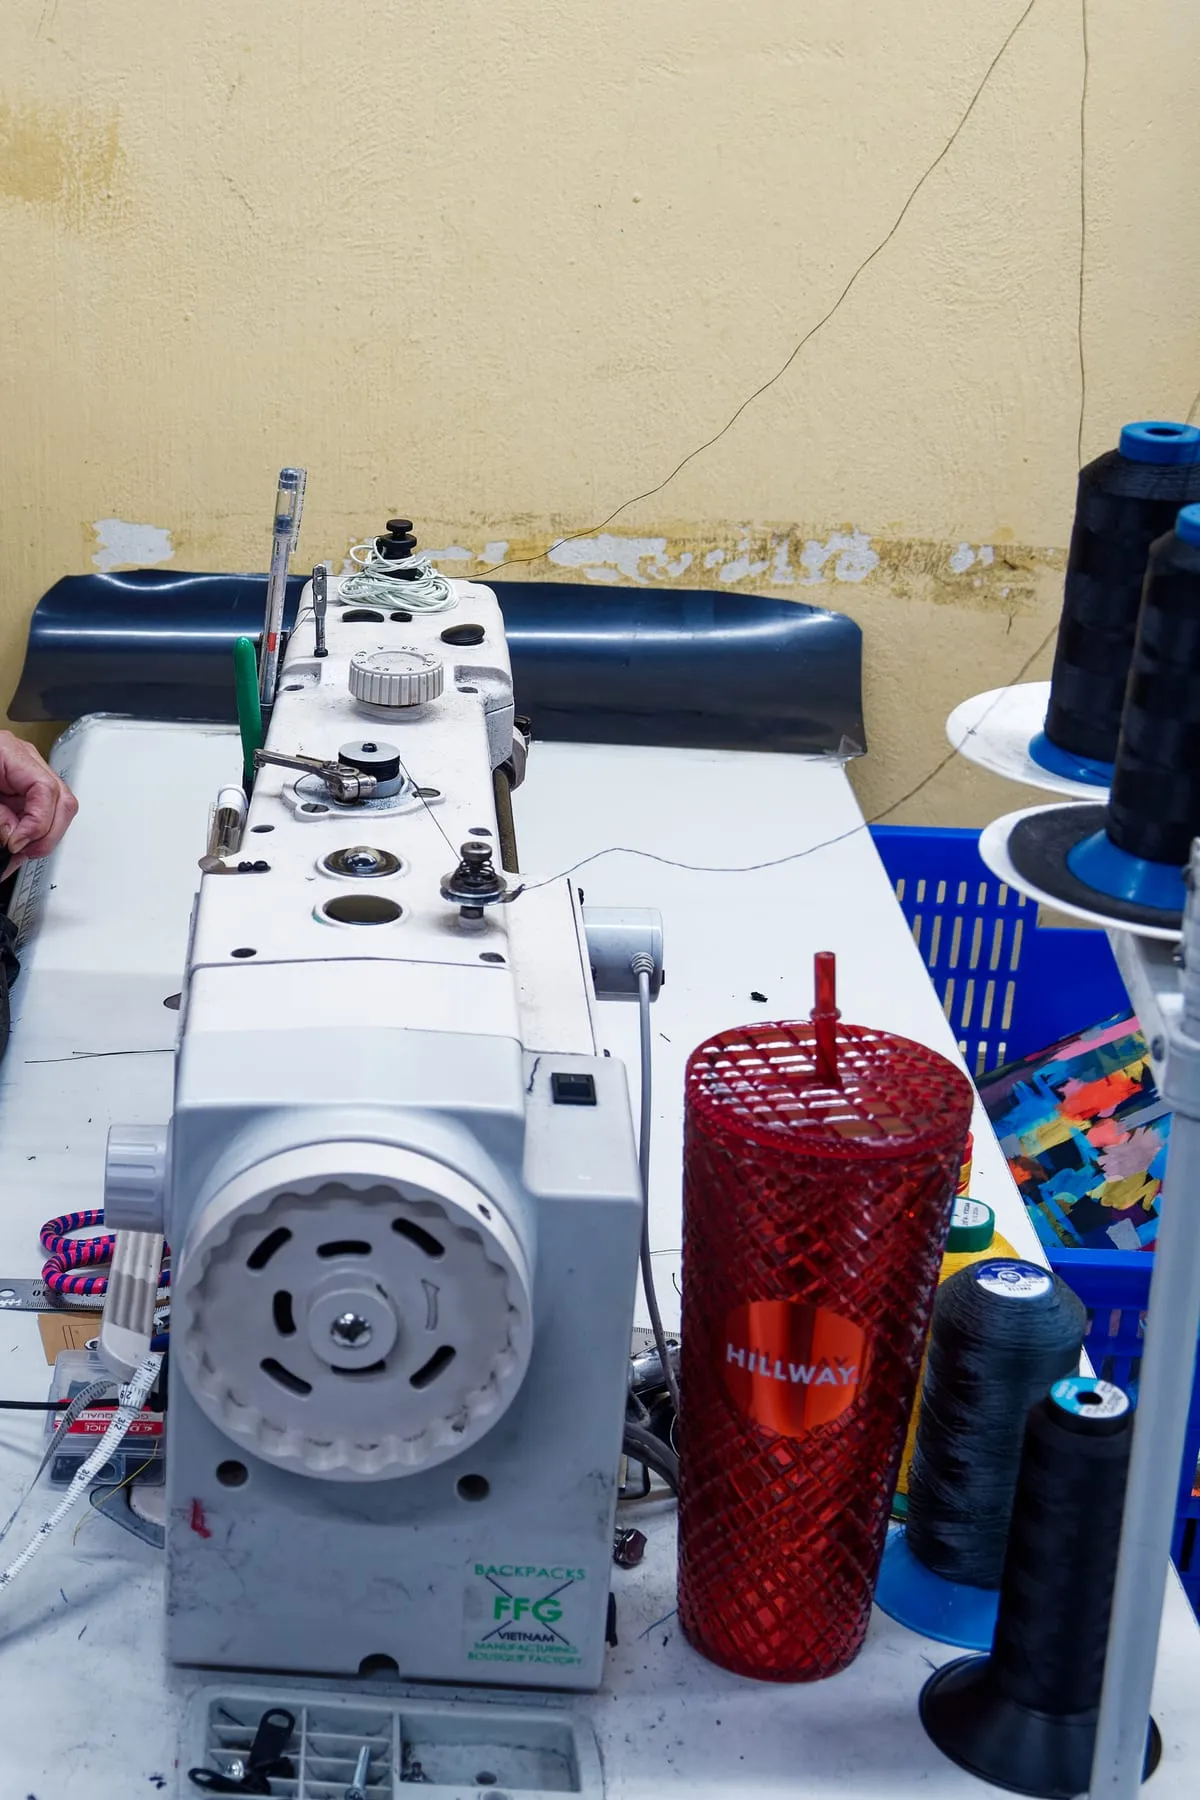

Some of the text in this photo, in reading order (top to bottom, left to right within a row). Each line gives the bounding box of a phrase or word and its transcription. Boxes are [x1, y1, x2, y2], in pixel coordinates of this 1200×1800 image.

[474, 1563, 586, 1580] BACKPACKS
[493, 1596, 563, 1623] FFG
[498, 1631, 555, 1642] VIETNAM
[474, 1642, 579, 1654] MANUFACTURING
[529, 1654, 582, 1666] FACTORY
